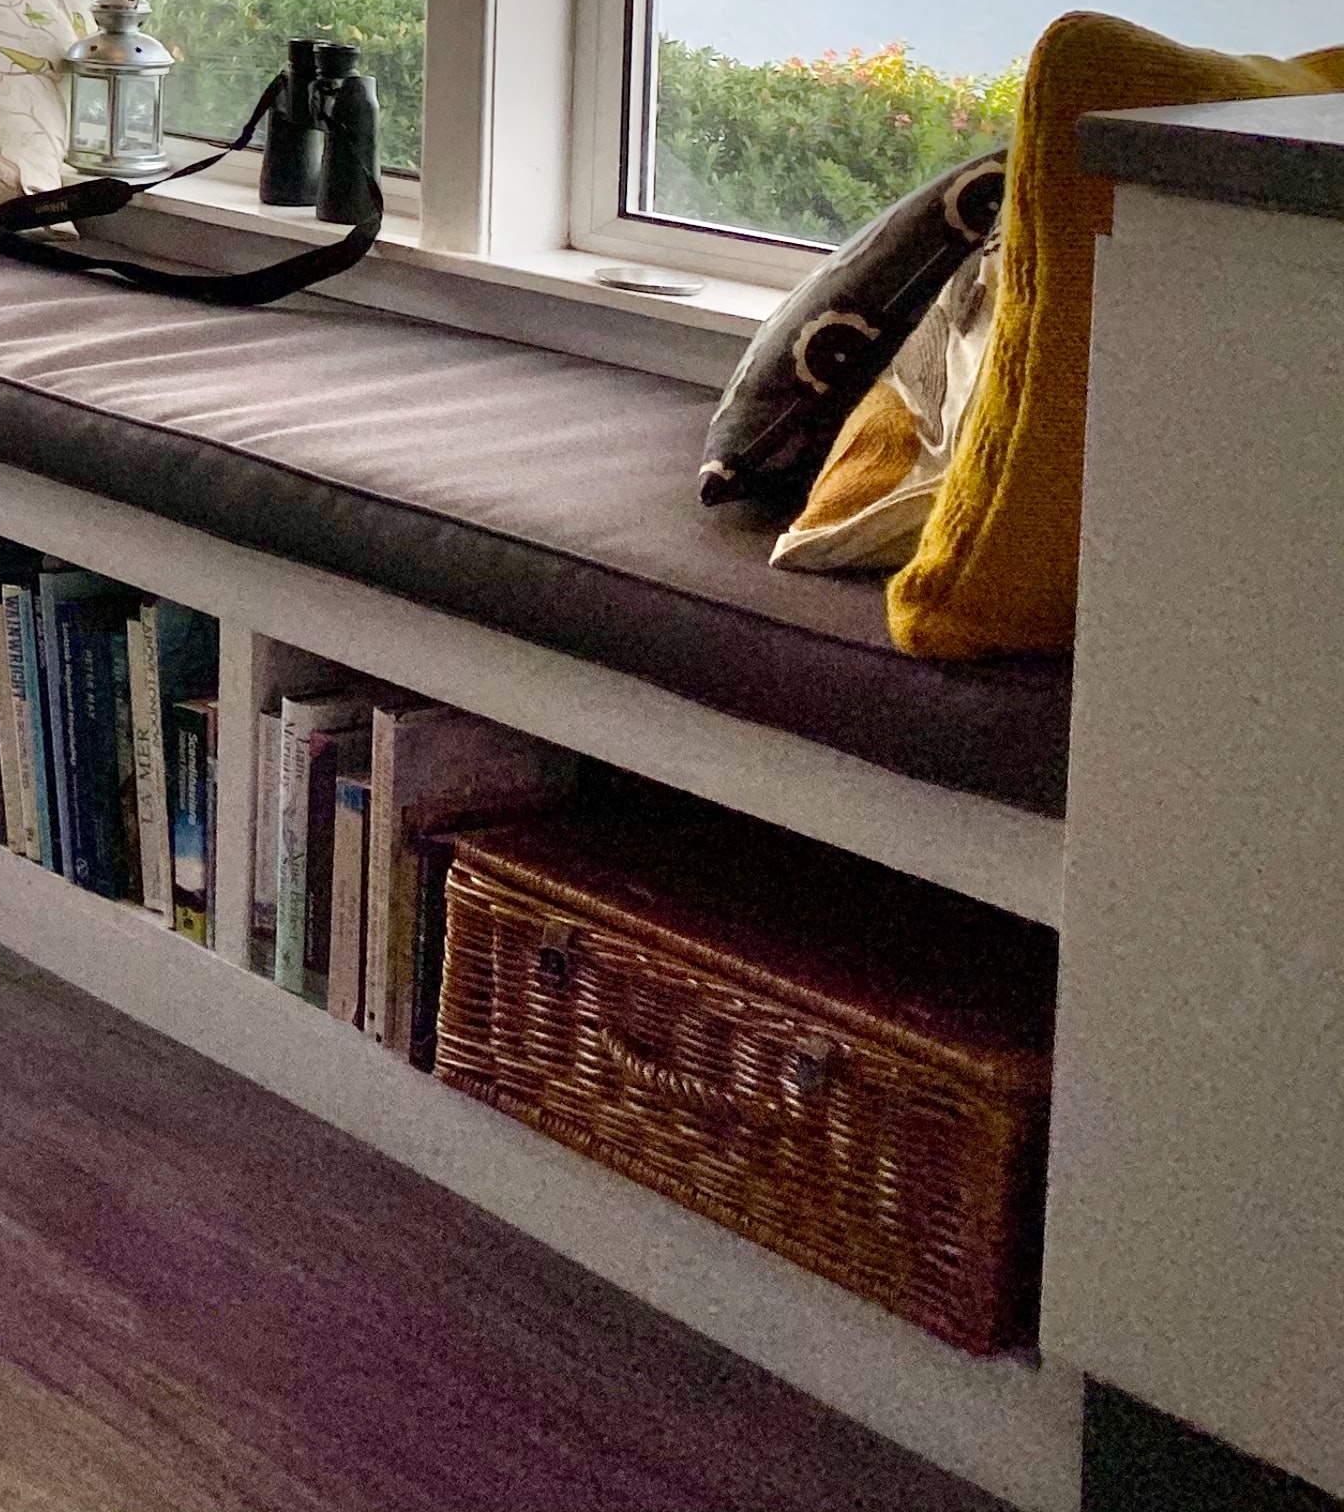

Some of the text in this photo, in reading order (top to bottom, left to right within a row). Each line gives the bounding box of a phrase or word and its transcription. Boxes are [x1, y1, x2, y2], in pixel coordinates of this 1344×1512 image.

[5, 596, 26, 701] WAINWRIGHT
[85, 649, 97, 720] PETER MAY
[137, 727, 153, 824] LA MER
[188, 733, 198, 825] Scandinavians
